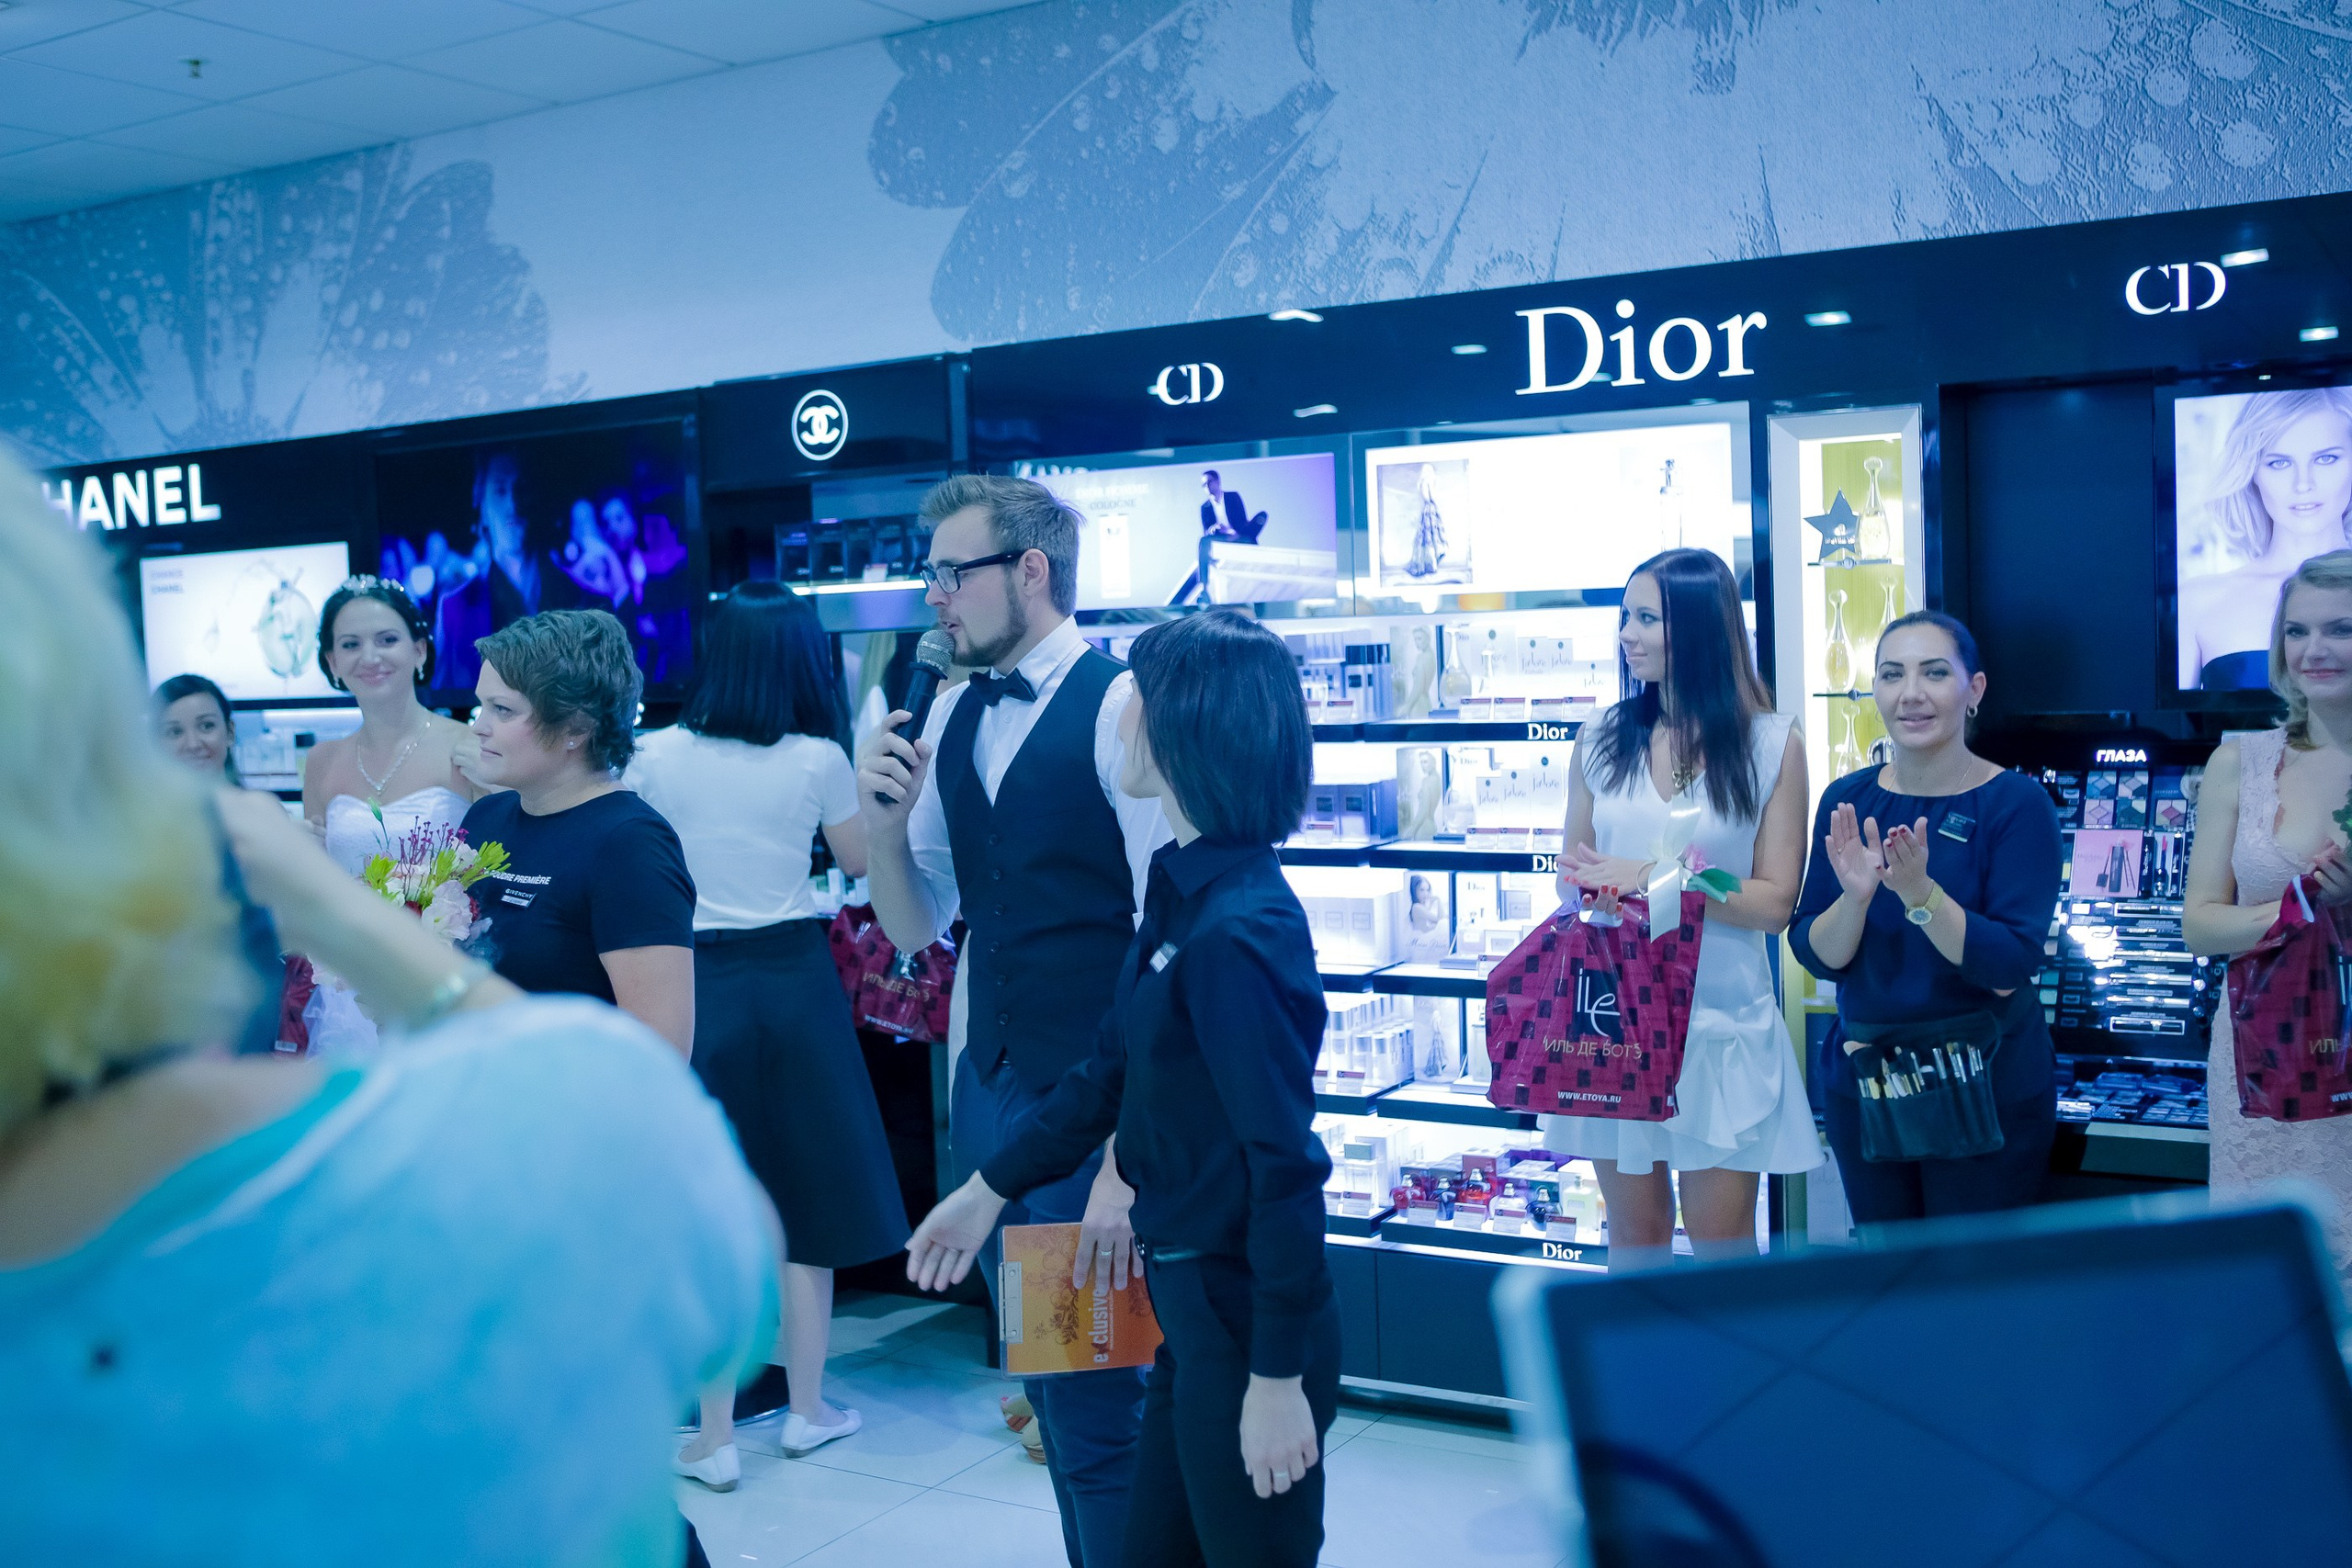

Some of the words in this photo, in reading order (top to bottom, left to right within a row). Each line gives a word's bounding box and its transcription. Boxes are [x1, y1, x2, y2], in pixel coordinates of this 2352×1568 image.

[2125, 261, 2227, 315] CD
[1515, 299, 1769, 397] Dior
[1156, 362, 1226, 406] CD
[41, 463, 221, 532] HANEL
[1090, 498, 1137, 511] COLOGNE
[1527, 723, 1569, 740] Dior
[2096, 749, 2148, 762] ГЛАЗА
[1532, 854, 1558, 873] Di
[514, 874, 551, 885] PREMIÈRE
[504, 888, 534, 899] GIVENCHY
[1544, 1038, 1575, 1054] ИЛЬ
[1577, 1042, 1598, 1057] ДЕ
[1601, 1043, 1643, 1060] БОТЭ
[1557, 1090, 1623, 1103] WWW.ETOYA.RU
[1543, 1242, 1583, 1261] Dior
